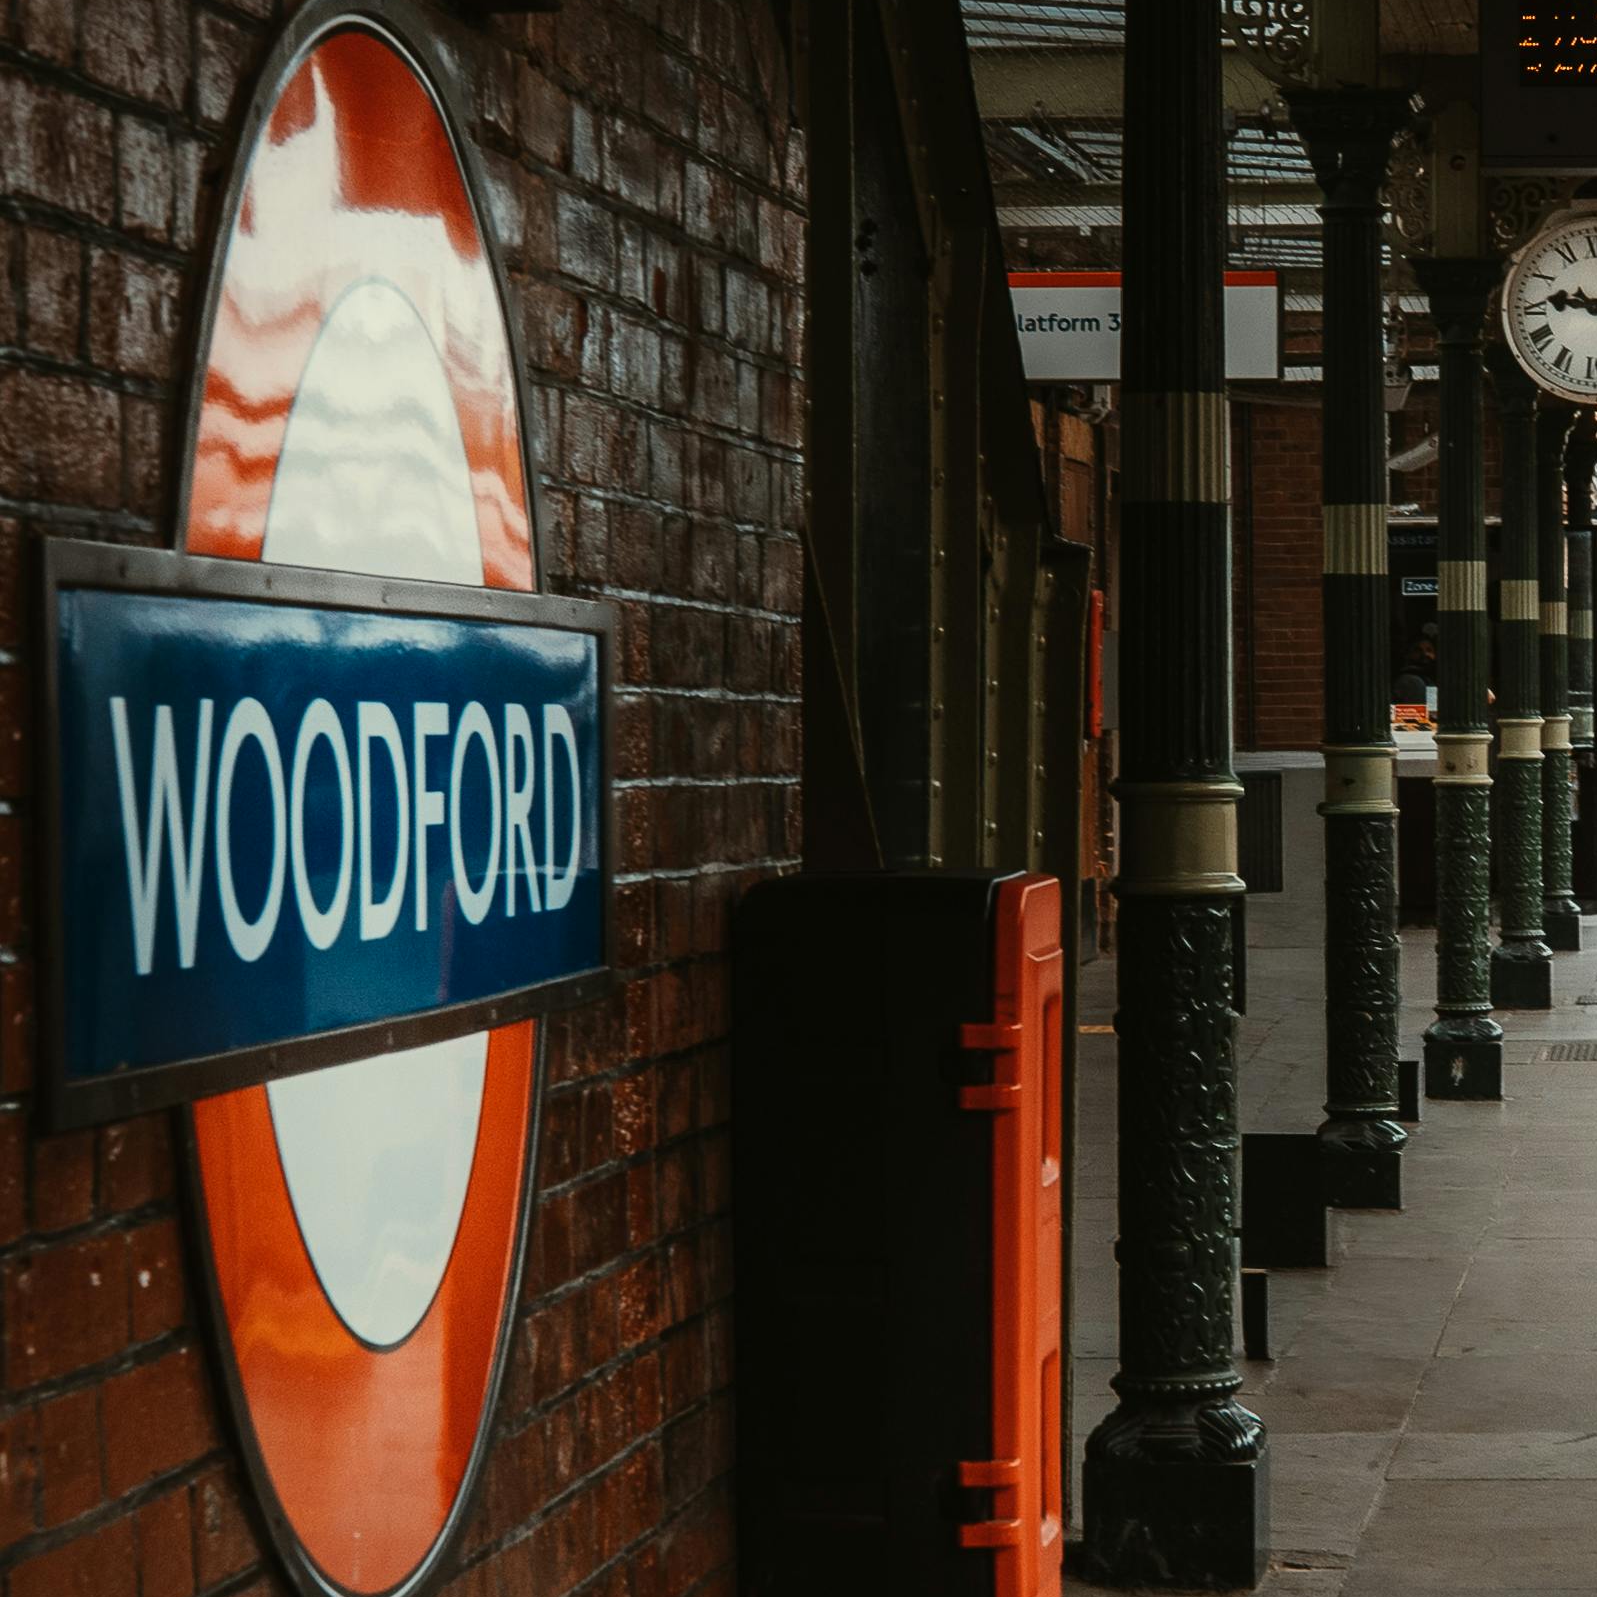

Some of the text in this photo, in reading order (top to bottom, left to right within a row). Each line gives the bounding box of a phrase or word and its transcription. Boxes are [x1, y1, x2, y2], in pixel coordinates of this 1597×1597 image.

[1017, 313, 1121, 332] latform 3
[1551, 344, 1575, 374] VII
[110, 696, 581, 976] WOODFORD
